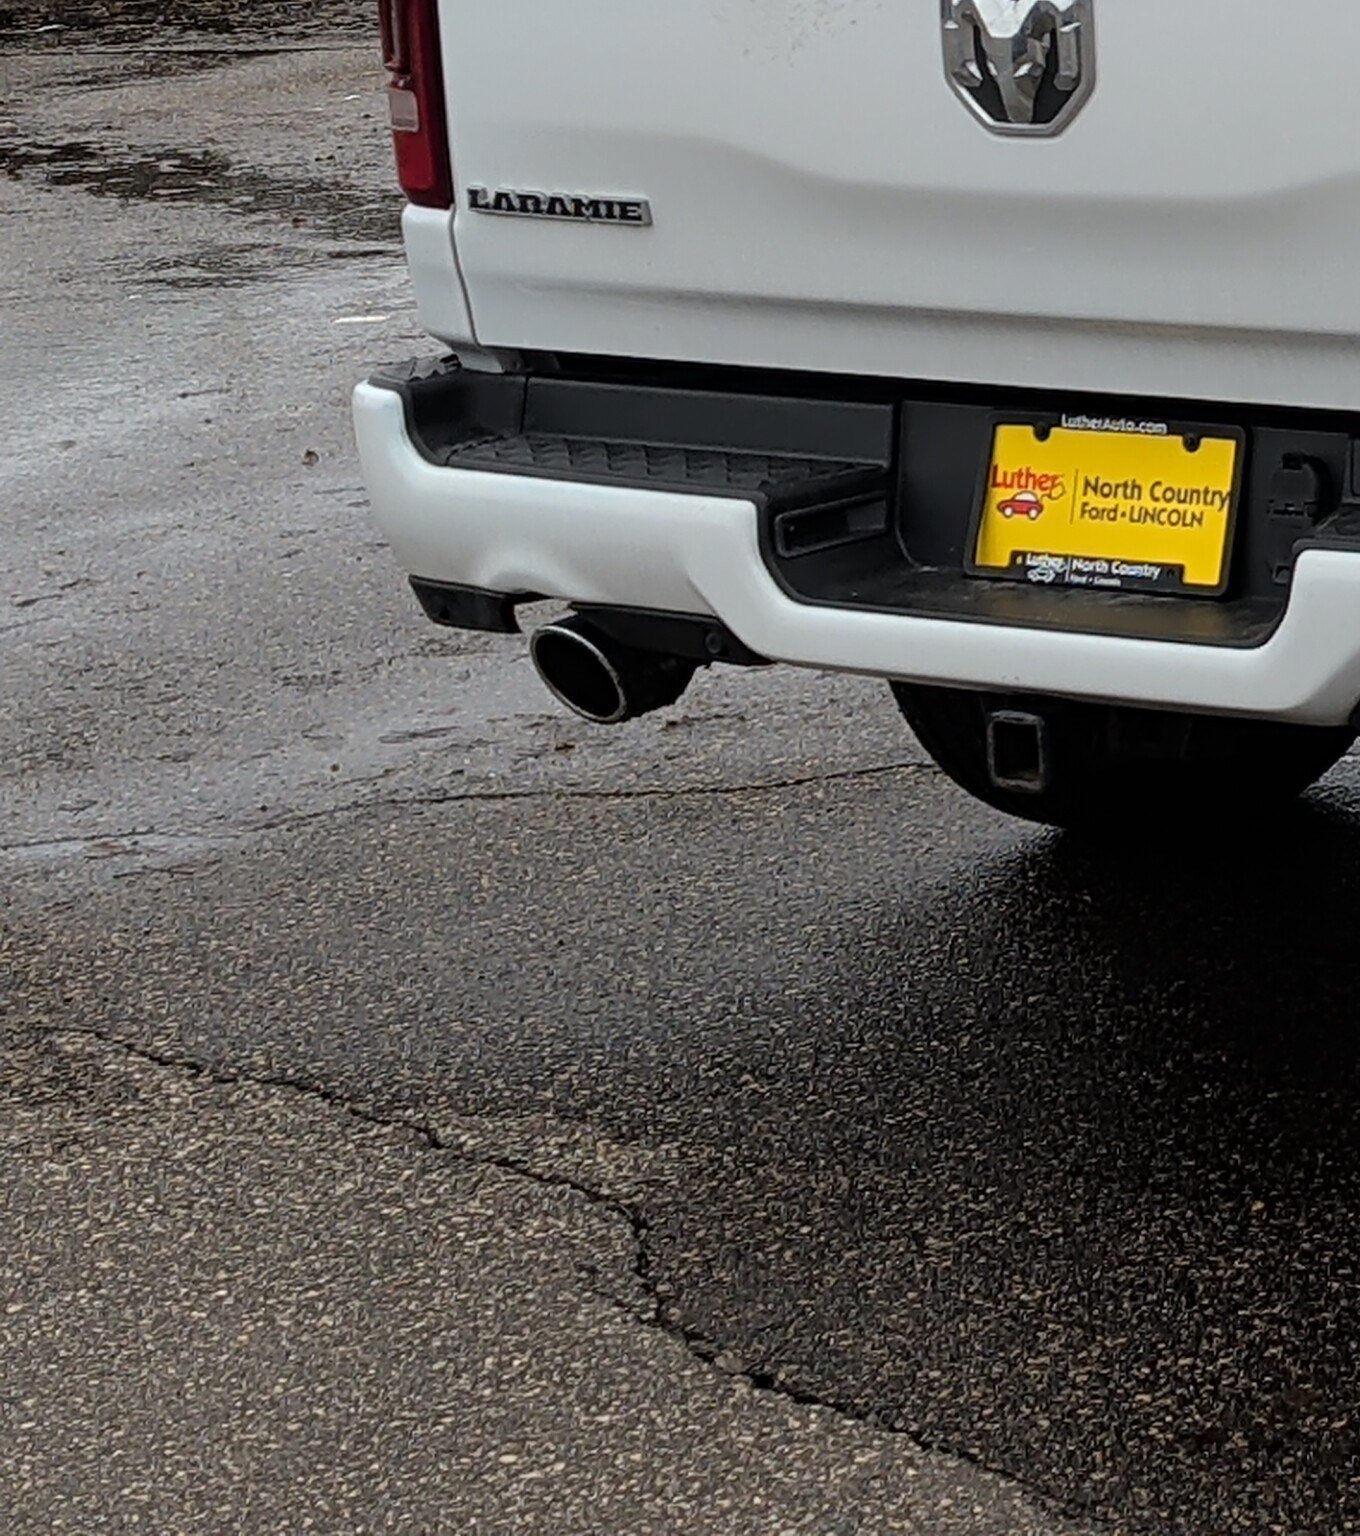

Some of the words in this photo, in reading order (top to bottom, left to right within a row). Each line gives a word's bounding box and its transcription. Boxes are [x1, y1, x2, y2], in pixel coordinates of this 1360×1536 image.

[467, 186, 645, 223] LARAMIE
[1061, 413, 1168, 435] LutherAuto.com
[991, 464, 1064, 493] Luther
[1082, 475, 1143, 501] North
[1150, 480, 1232, 512] Country
[1079, 501, 1118, 522] Ford
[1129, 505, 1205, 529] LINCOLN
[1072, 557, 1109, 574] North
